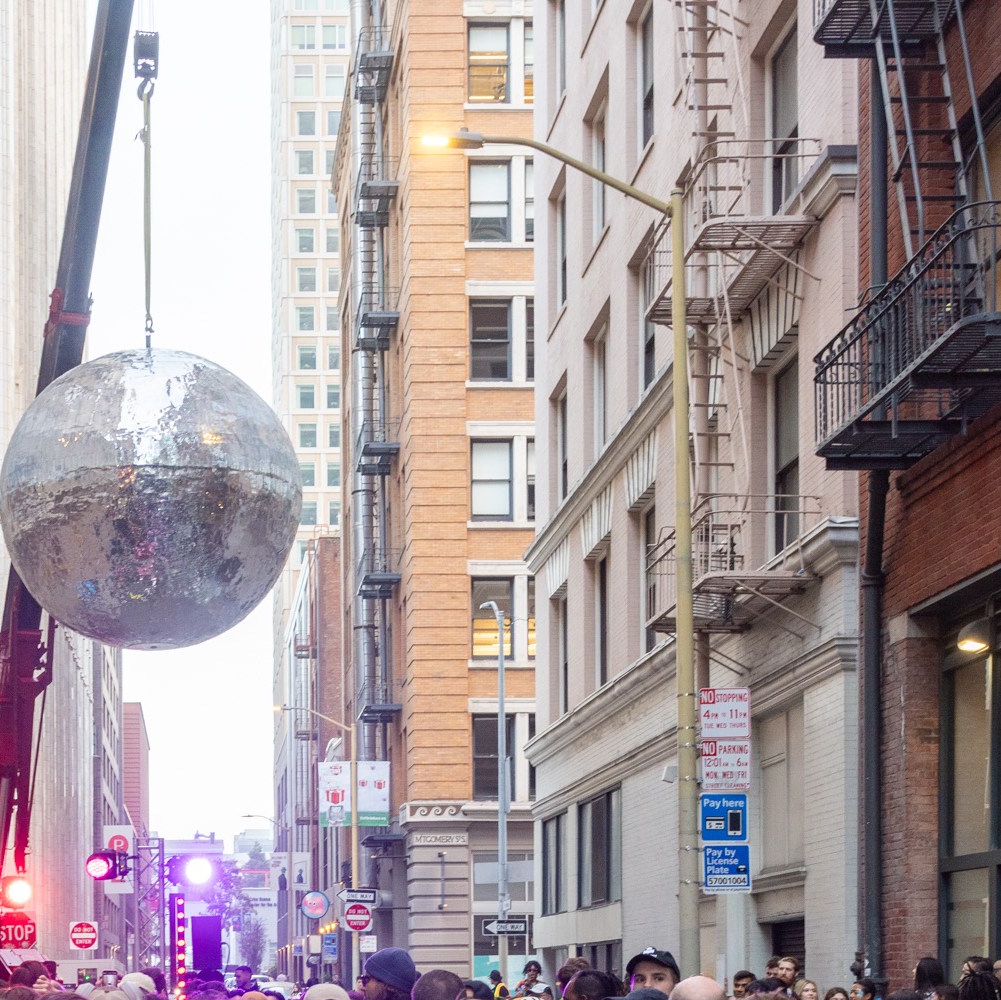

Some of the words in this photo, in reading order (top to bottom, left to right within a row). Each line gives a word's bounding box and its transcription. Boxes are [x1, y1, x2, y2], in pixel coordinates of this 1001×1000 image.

[701, 690, 714, 704] NO
[716, 693, 748, 703] STOPPING
[702, 742, 715, 755] NO
[718, 745, 748, 755] PARKING
[705, 771, 718, 779] MON
[722, 771, 734, 779] WED
[737, 771, 747, 779] FRI
[703, 798, 721, 809] Pay
[722, 798, 745, 807] here
[706, 848, 723, 858] Pay
[724, 848, 736, 857] by
[706, 857, 739, 865] License
[706, 866, 730, 874] Plate
[708, 877, 747, 885] 57001004
